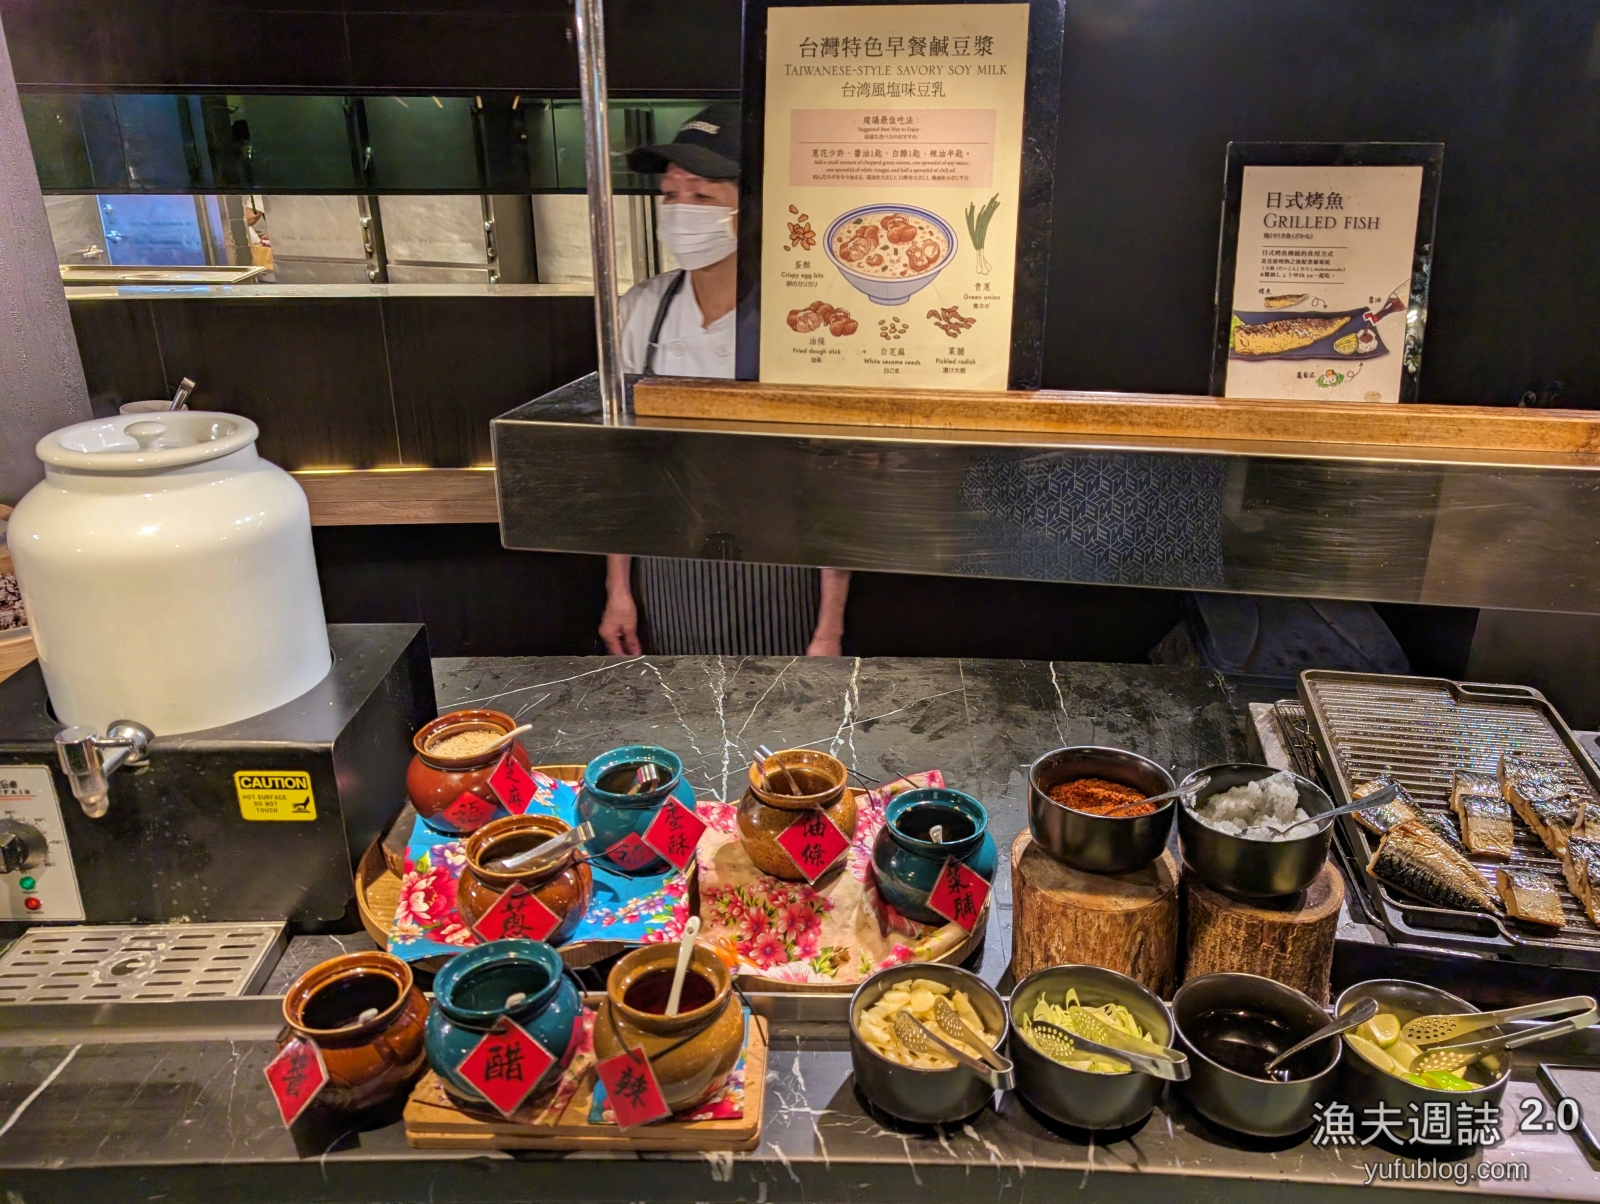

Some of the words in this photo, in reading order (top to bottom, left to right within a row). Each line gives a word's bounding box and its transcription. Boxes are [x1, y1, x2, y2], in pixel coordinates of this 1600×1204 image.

[798, 35, 995, 58] 台灣特色早餐鹹豆漿
[784, 63, 892, 76] TAIWANESE-STYLE
[896, 64, 944, 76] SAVORY
[948, 64, 973, 76] SOY
[976, 64, 1008, 76] MILK
[841, 81, 946, 98] 台湾風塩味豆乳
[1266, 191, 1344, 210] 日式烤魚
[1263, 212, 1337, 229] GRILLED
[1343, 216, 1381, 230] FISH
[781, 271, 800, 280] Crispy
[963, 293, 983, 301] Green
[809, 348, 827, 356] dough
[239, 776, 308, 790] CAUTION
[801, 810, 826, 868] 油條
[484, 1041, 525, 1082] 醋
[613, 1066, 648, 1110] 辣
